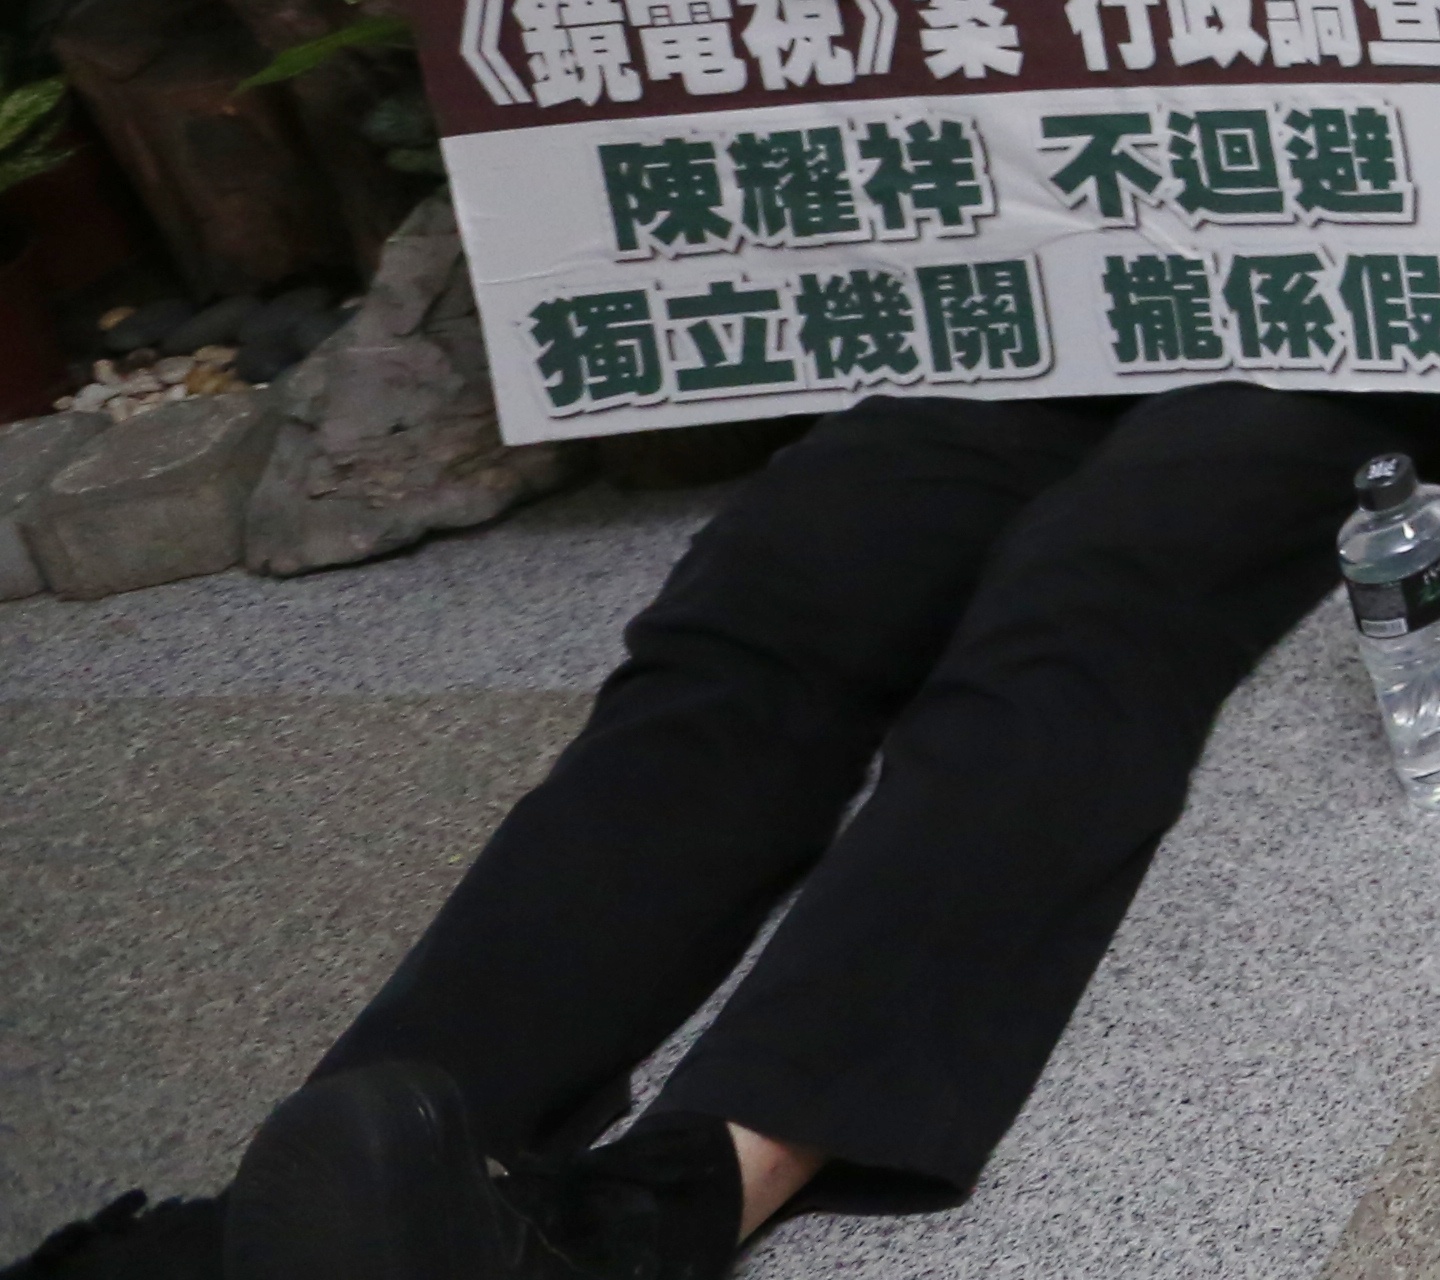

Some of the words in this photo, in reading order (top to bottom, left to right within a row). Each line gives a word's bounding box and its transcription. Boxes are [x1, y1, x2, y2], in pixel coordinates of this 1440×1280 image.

[597, 118, 990, 255] 陳耀祥
[1038, 104, 1408, 223] 不迴避
[524, 255, 1042, 412] 獨立機關
